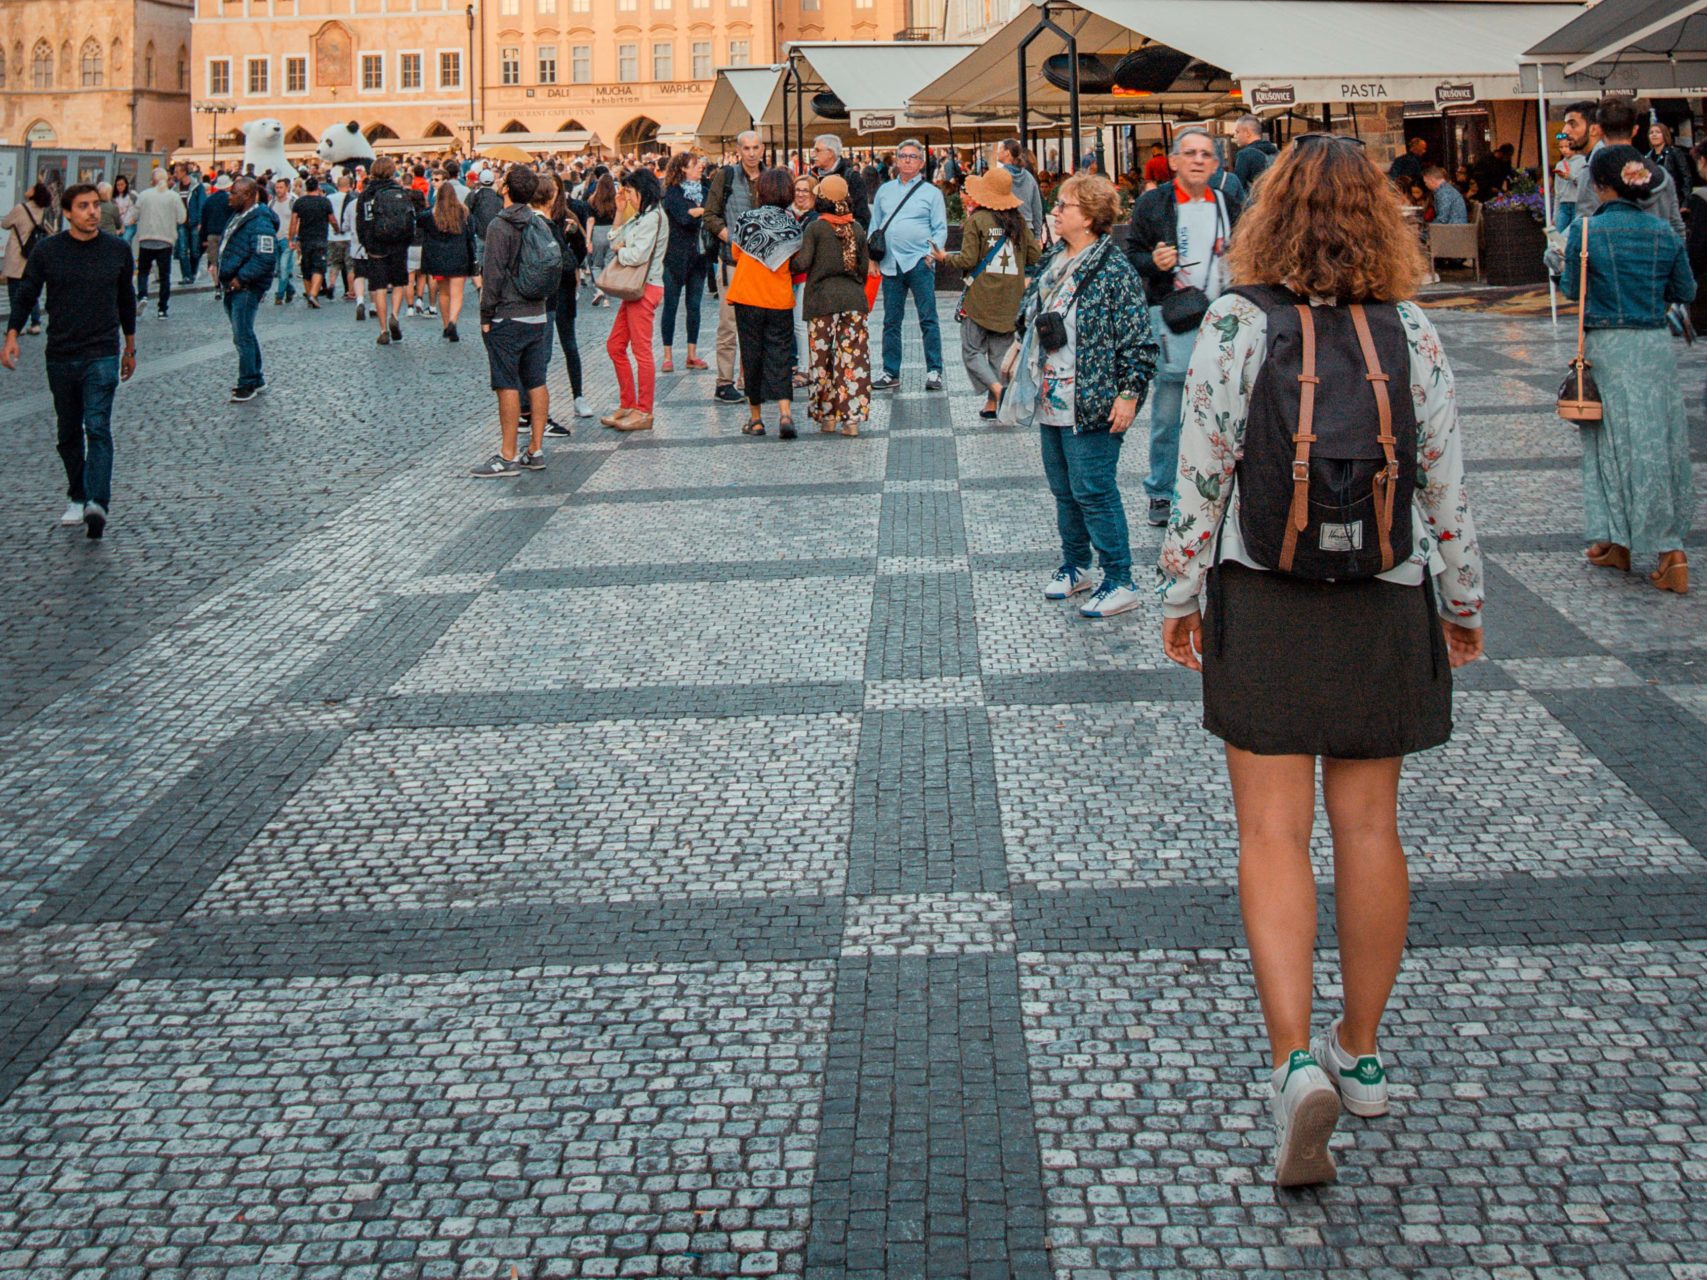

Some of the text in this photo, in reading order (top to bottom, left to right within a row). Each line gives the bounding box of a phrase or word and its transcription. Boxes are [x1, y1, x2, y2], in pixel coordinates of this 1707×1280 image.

[596, 86, 632, 95] MUCHA
[660, 84, 703, 94] WARHOL
[1341, 84, 1387, 97] PASTA
